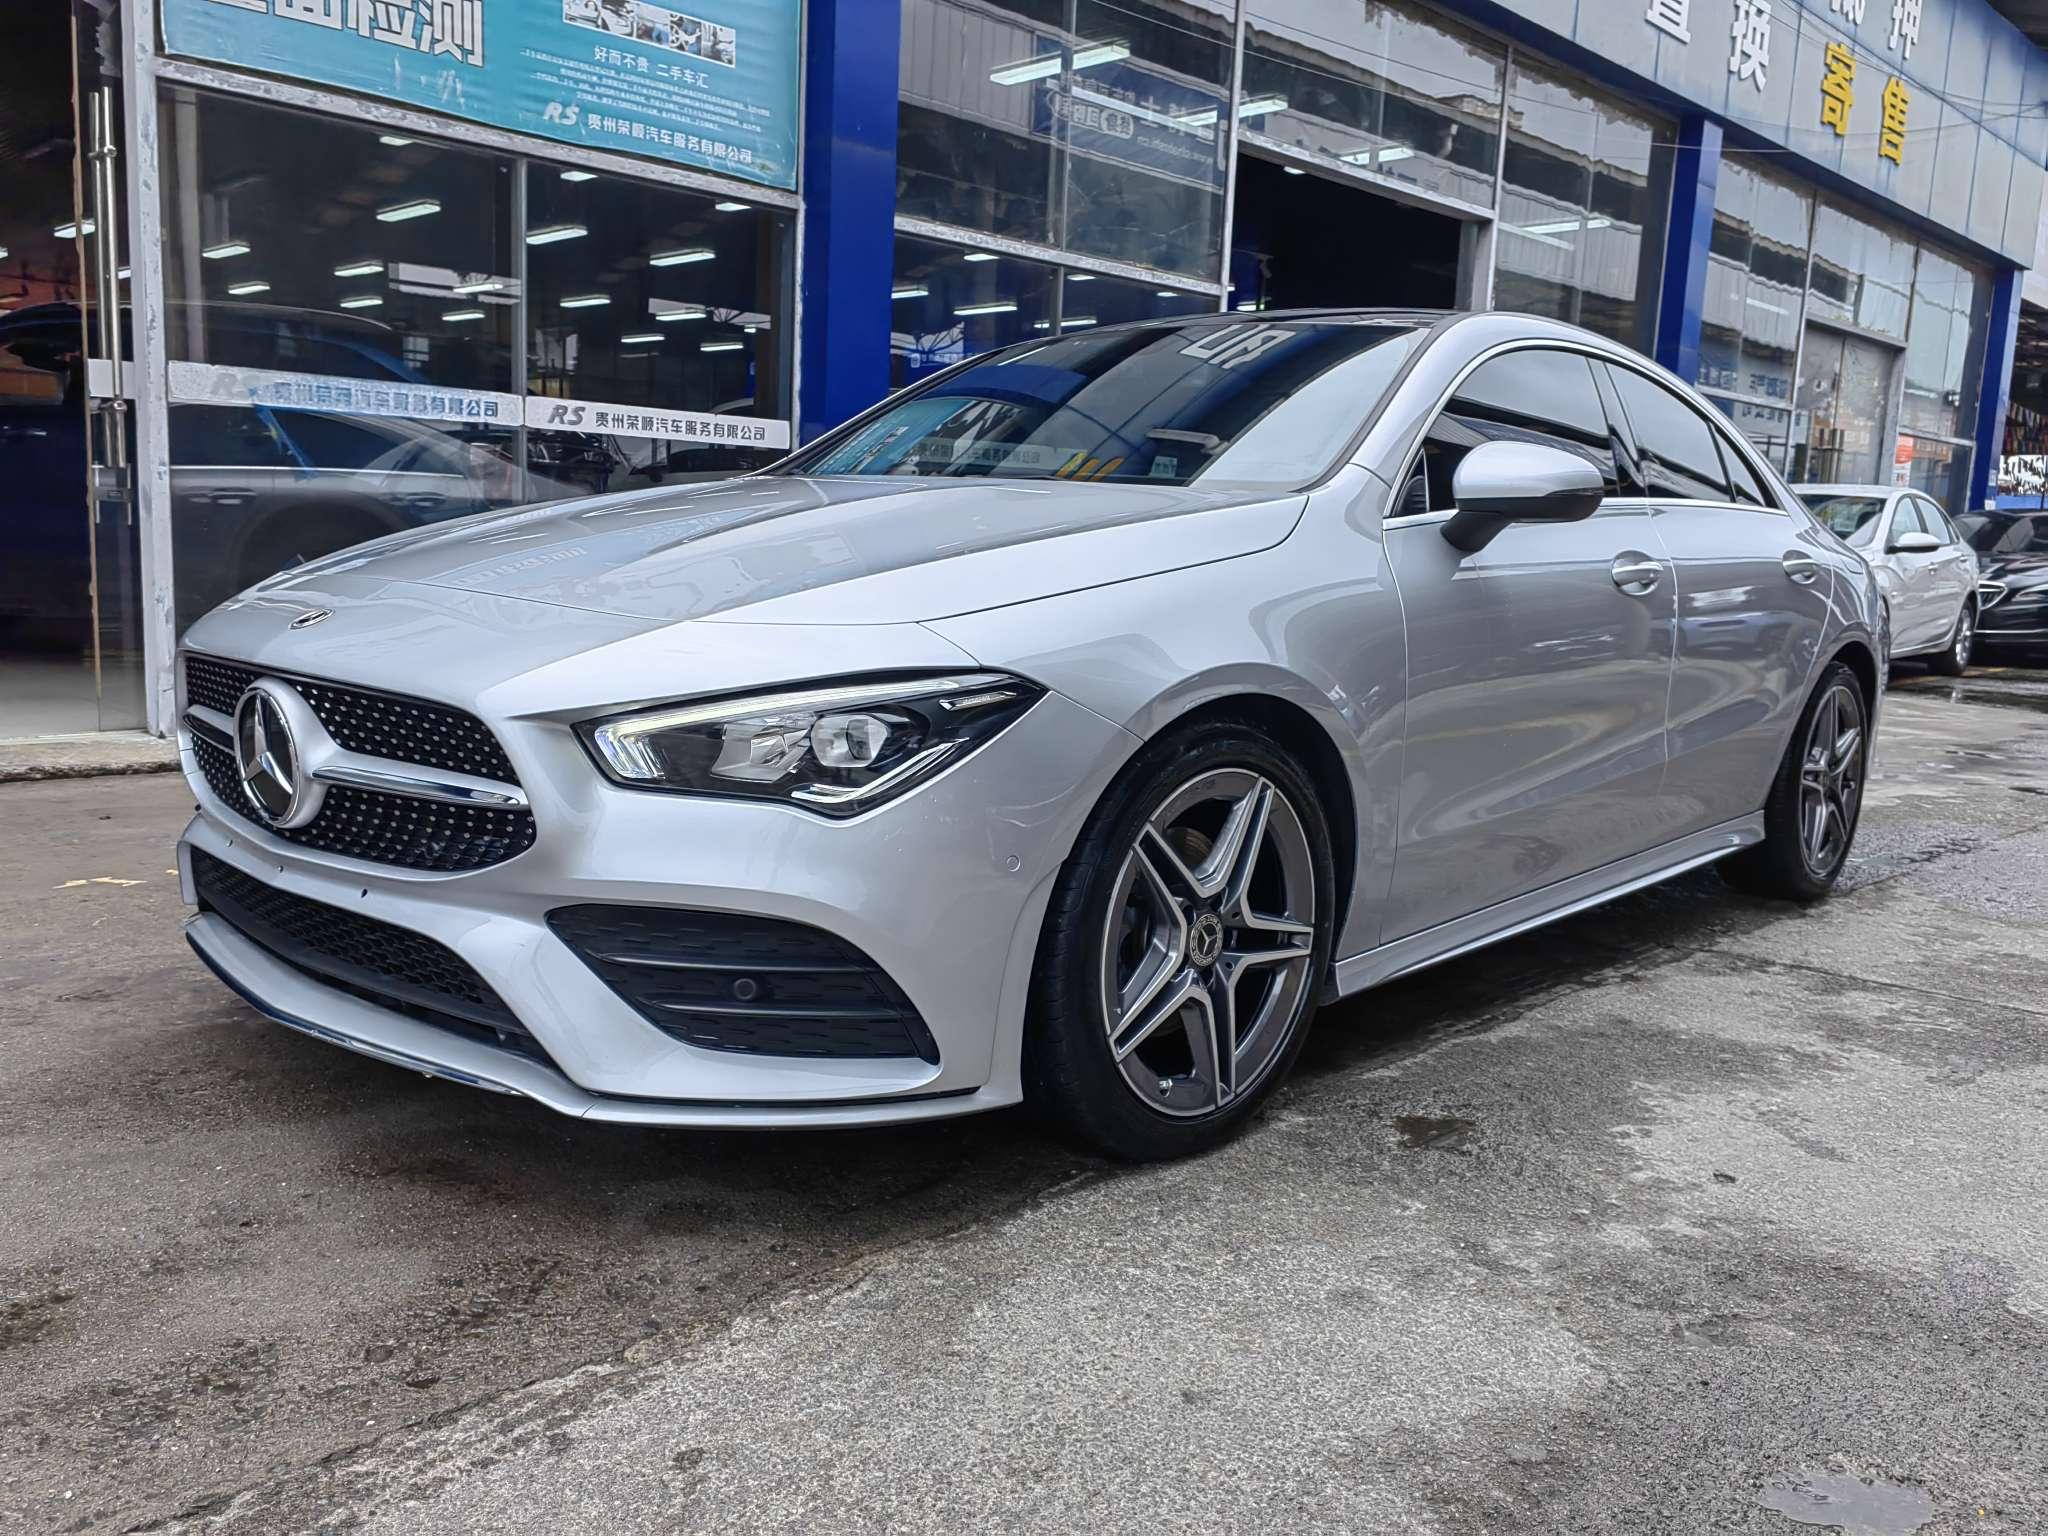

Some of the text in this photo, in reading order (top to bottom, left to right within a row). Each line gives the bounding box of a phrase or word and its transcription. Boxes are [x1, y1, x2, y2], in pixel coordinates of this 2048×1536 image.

[206, 0, 484, 68] 检测
[1829, 0, 1925, 60] 押
[594, 46, 709, 89] 好而不贵 二手车汇
[543, 102, 580, 126] RS
[1819, 41, 1911, 166] 寄售
[549, 404, 766, 441] RS 贵州荣顺汽车服务有限公司
